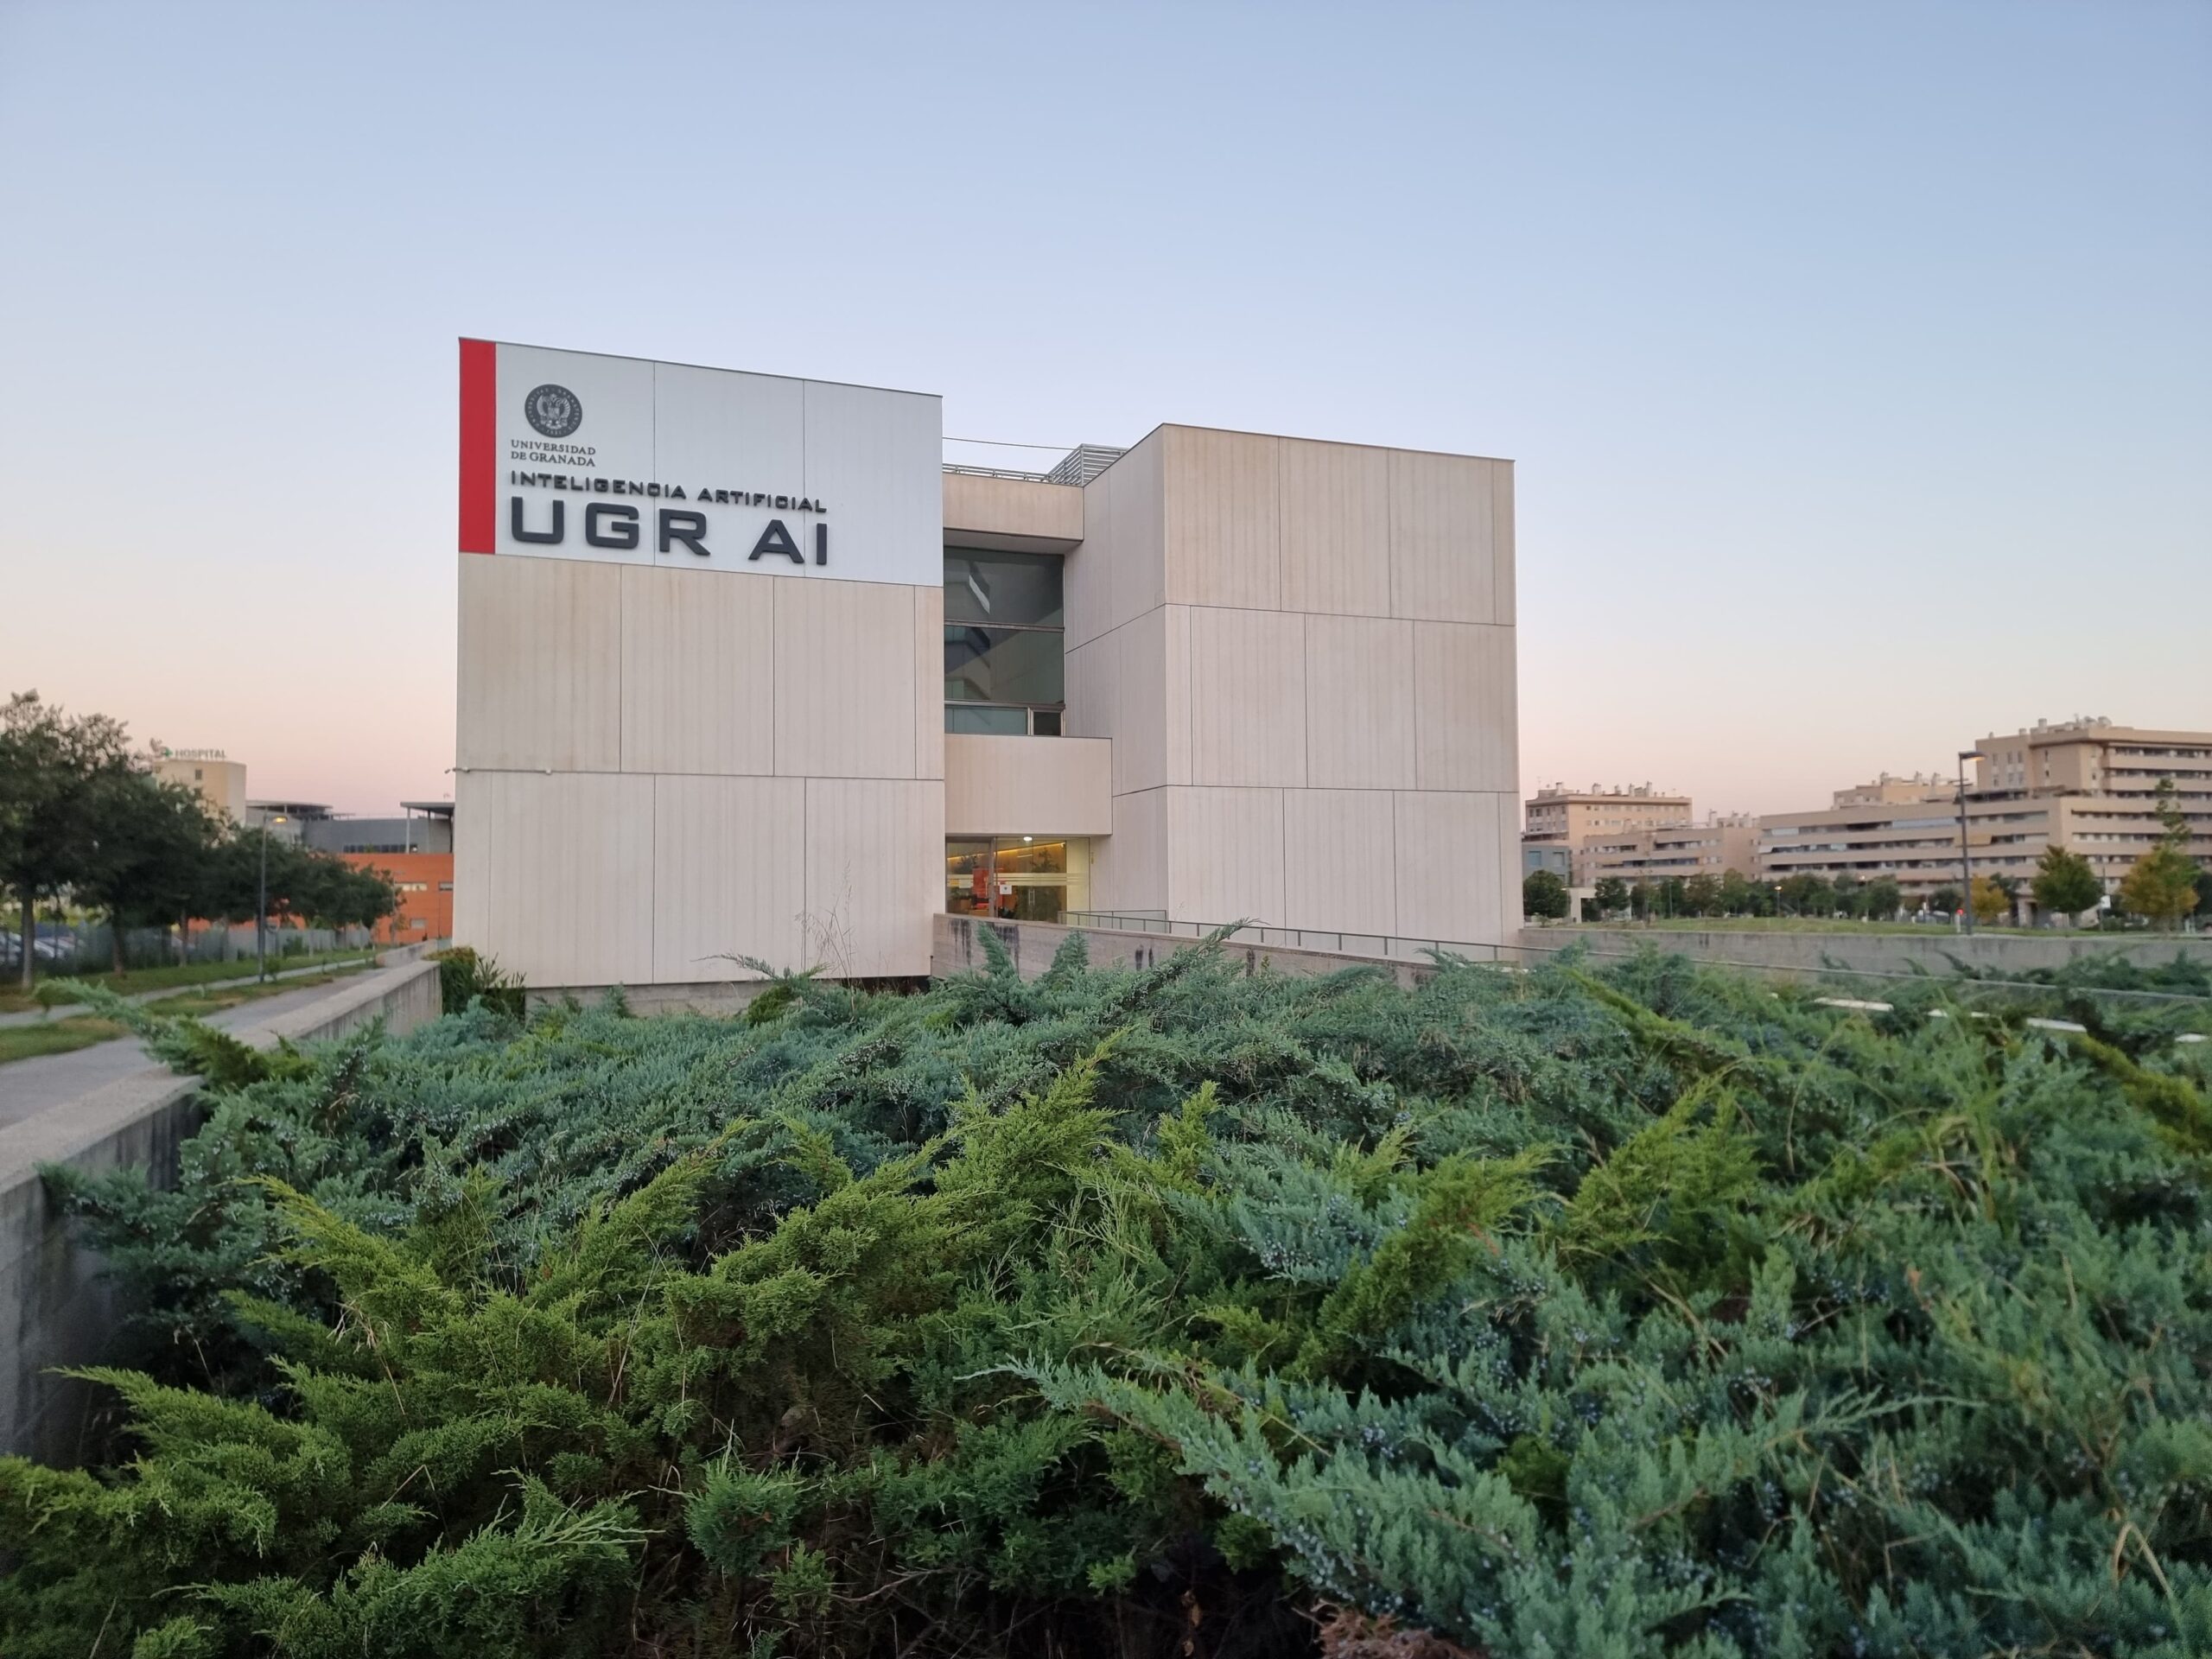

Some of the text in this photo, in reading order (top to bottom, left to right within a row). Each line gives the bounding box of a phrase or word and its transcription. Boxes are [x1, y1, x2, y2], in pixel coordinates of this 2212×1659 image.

[512, 440, 595, 455] UNIVERSIDAD
[512, 451, 595, 467] DE GRANADA
[512, 470, 827, 513] INTELIGENCIA ARTIFICIAL
[512, 496, 828, 565] UGR AI
[175, 748, 226, 759] HOSPITAL
